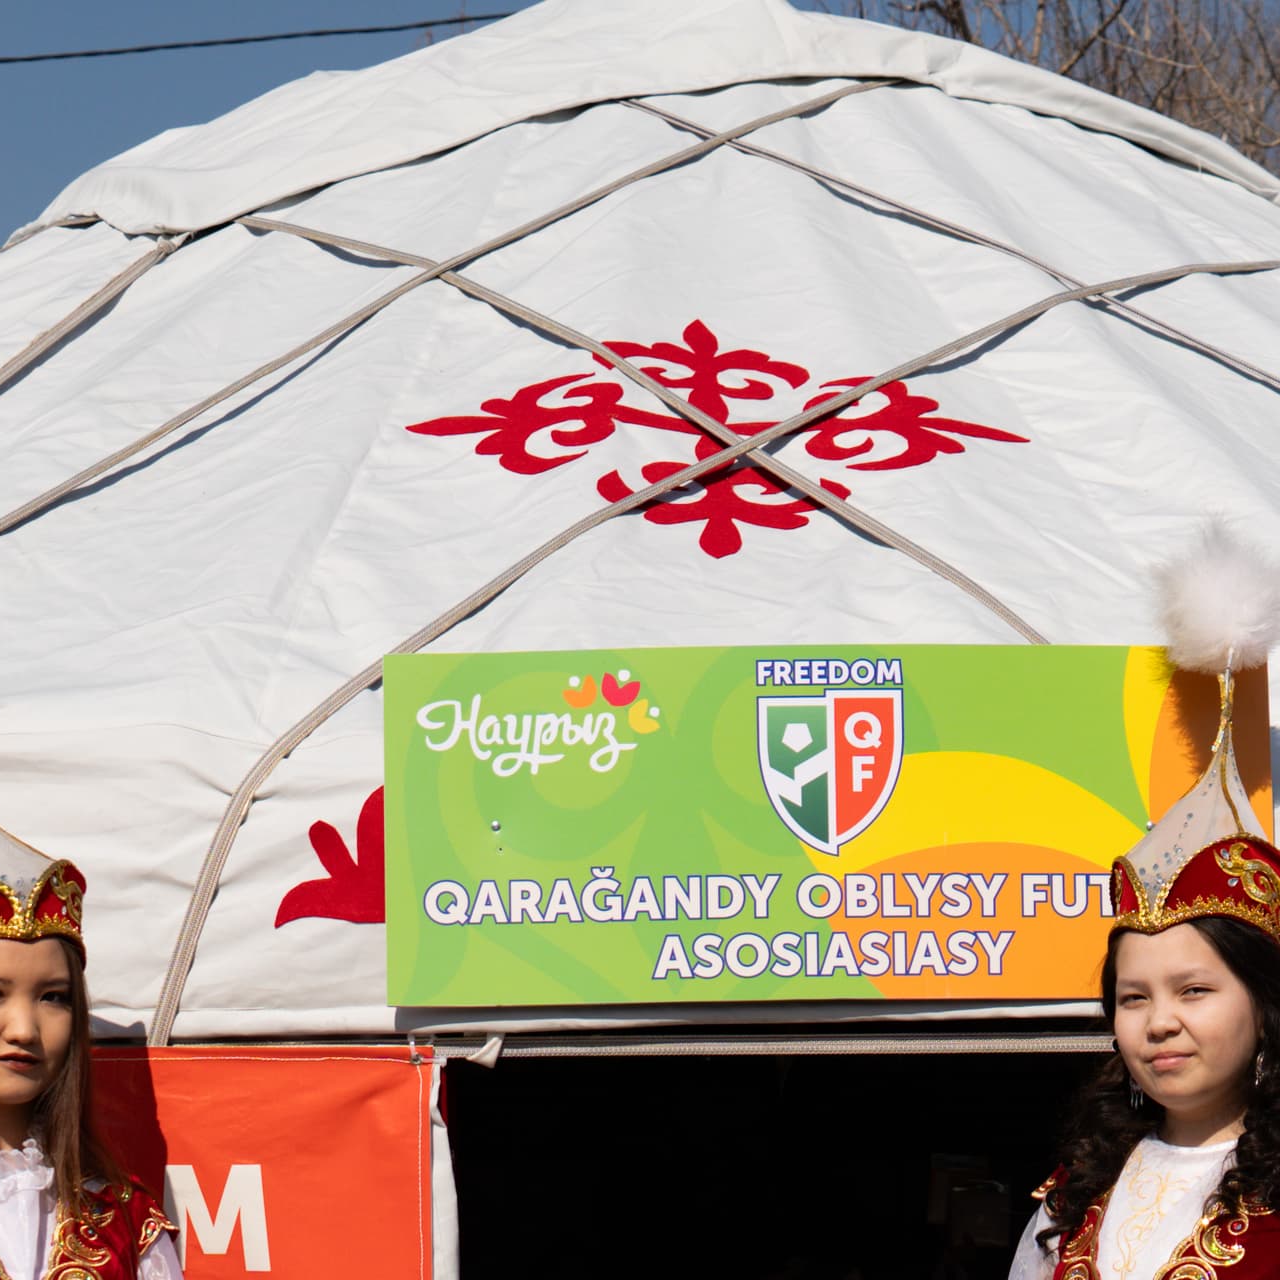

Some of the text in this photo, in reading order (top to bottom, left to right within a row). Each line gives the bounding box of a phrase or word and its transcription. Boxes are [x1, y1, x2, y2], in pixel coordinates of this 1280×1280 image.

[756, 659, 904, 687] FREEDOM
[416, 693, 638, 777] Наурыз
[844, 711, 883, 749] Q
[851, 755, 875, 792] F
[423, 866, 782, 925] QARAĞANDY
[796, 872, 1009, 918] OBLYSY
[652, 931, 1015, 979] ASOSIASIASY
